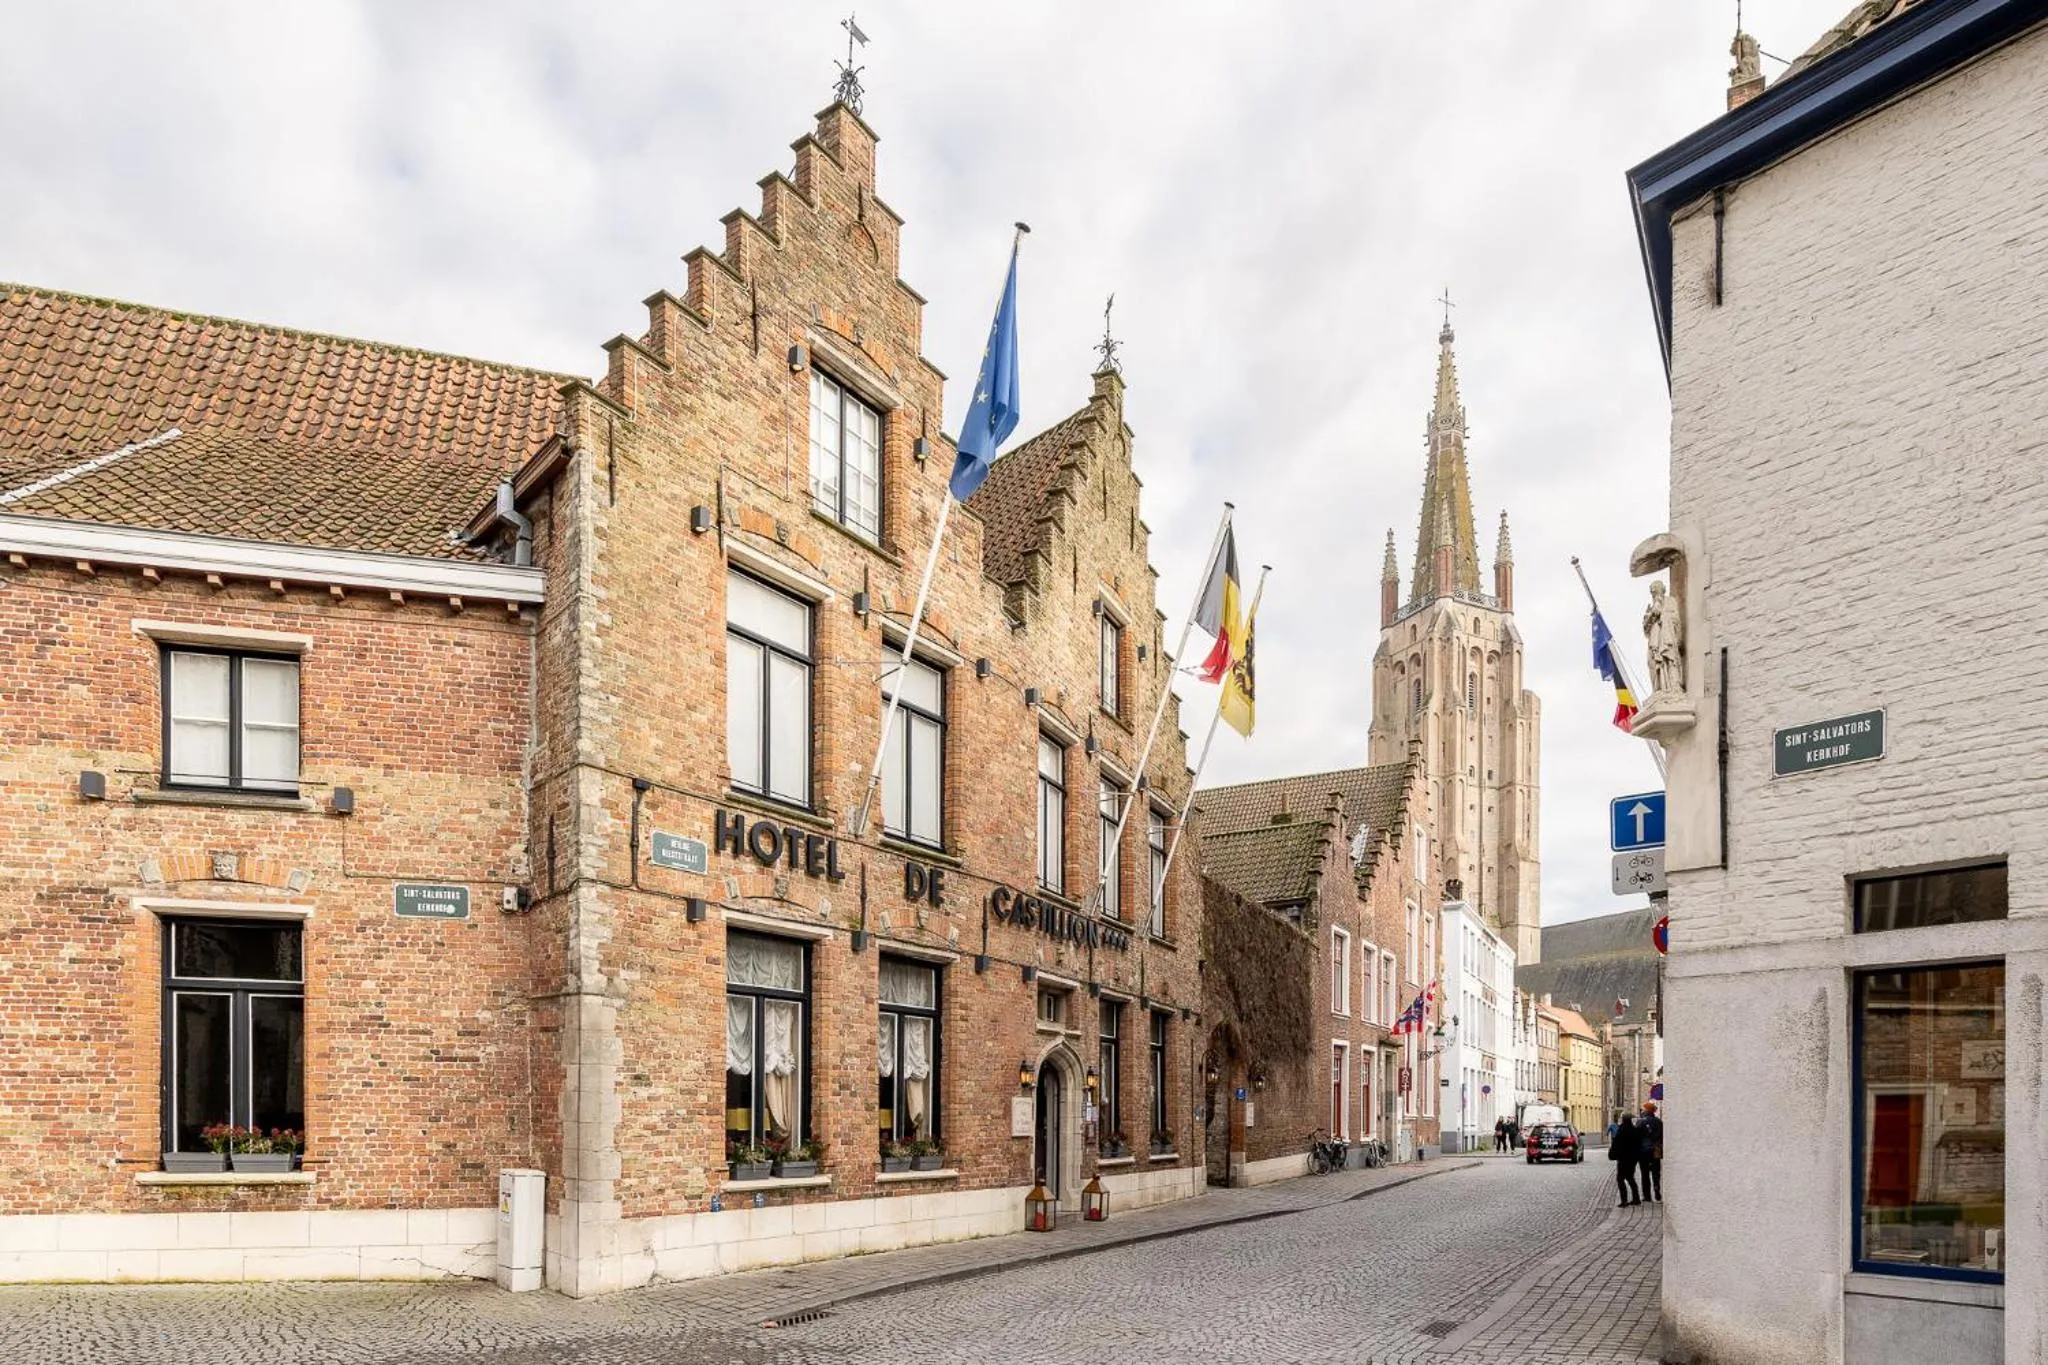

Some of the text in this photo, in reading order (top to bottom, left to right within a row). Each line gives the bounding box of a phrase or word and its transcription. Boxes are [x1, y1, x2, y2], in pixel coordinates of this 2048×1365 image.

[1785, 720, 1871, 747] SINT-SALVATORS
[1806, 743, 1851, 763] KERKHOF
[716, 809, 1098, 949] HOTEL DE CASTILLION
